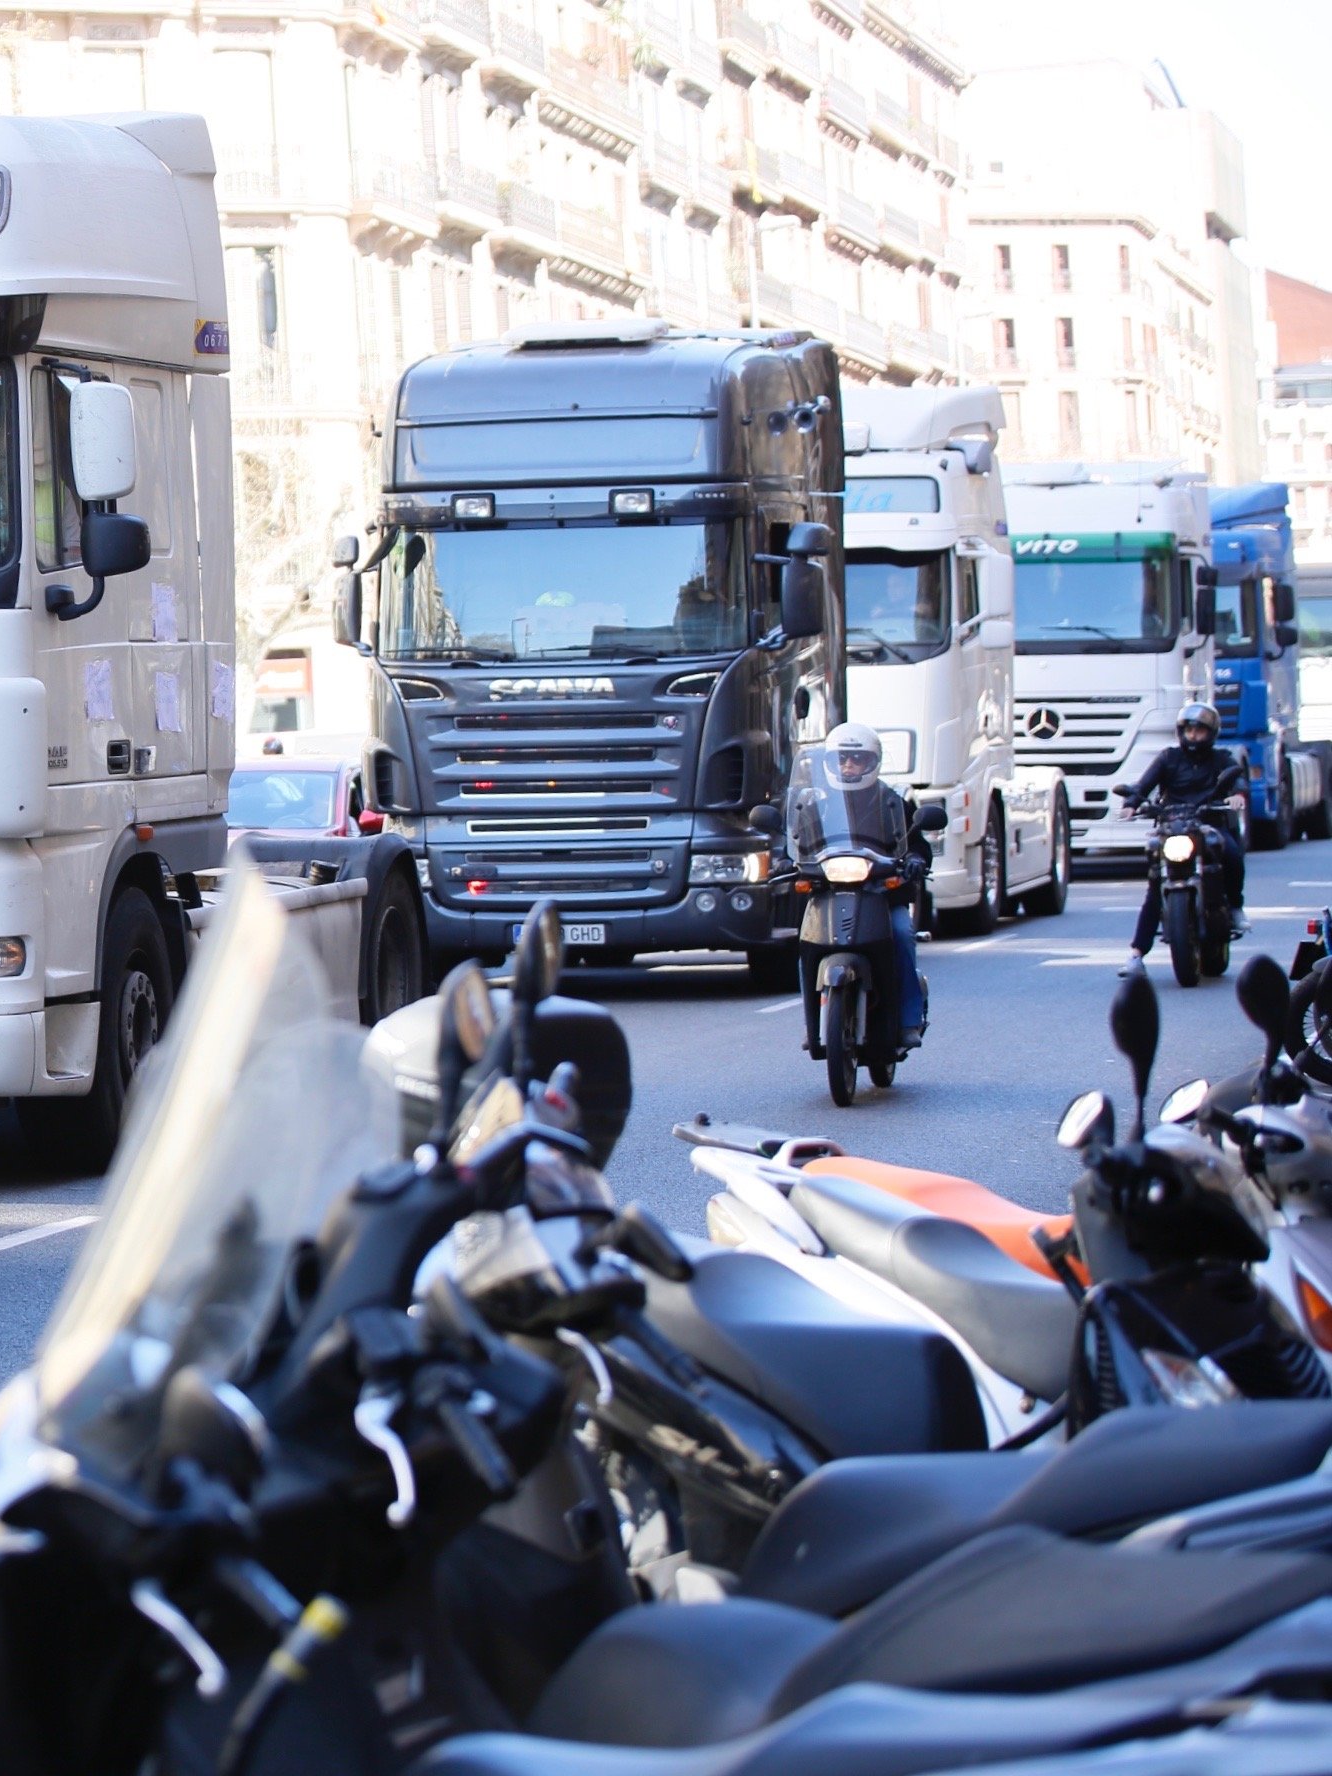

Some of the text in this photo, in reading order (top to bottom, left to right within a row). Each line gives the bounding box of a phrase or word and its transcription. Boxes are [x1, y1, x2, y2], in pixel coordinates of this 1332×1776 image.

[1015, 538, 1079, 555] VITO
[489, 677, 616, 701] SCANIA
[570, 926, 601, 942] GHD
